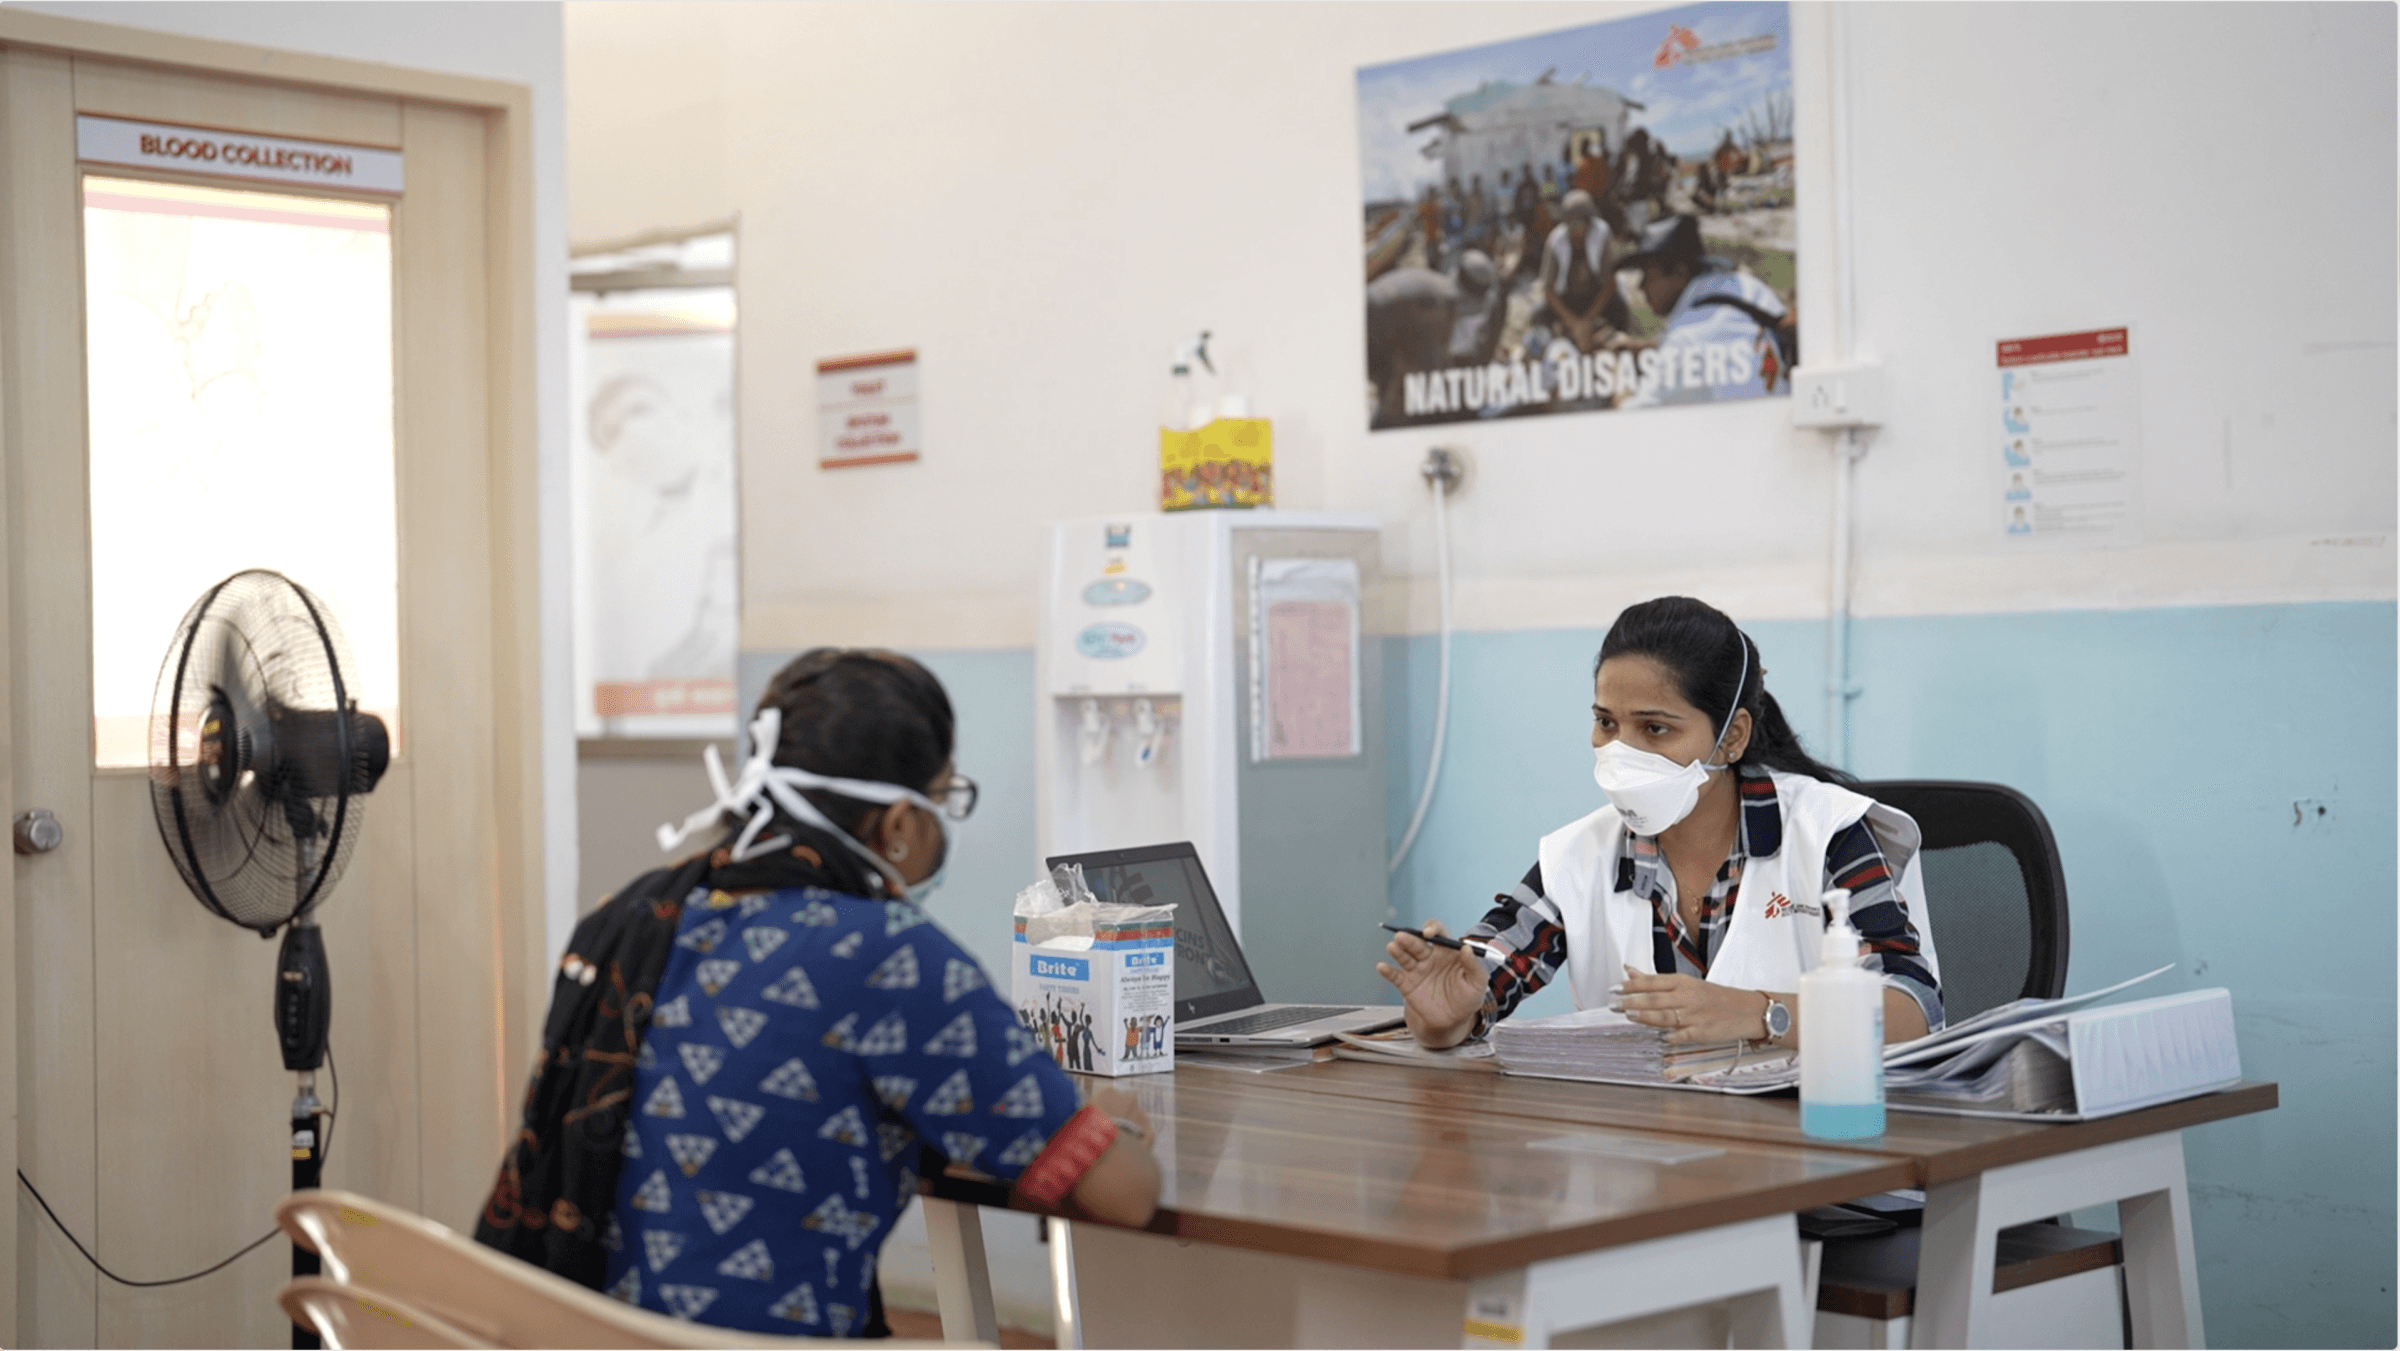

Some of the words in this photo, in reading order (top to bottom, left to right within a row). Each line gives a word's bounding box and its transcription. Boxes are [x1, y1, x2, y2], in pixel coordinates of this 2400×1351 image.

[140, 133, 218, 161] BLOOD
[221, 142, 353, 175] COLLECTION
[1404, 361, 1549, 416] NATURAL
[1558, 338, 1751, 400] DISASTERS
[1038, 960, 1077, 977] Brite
[1175, 943, 1205, 966] RON
